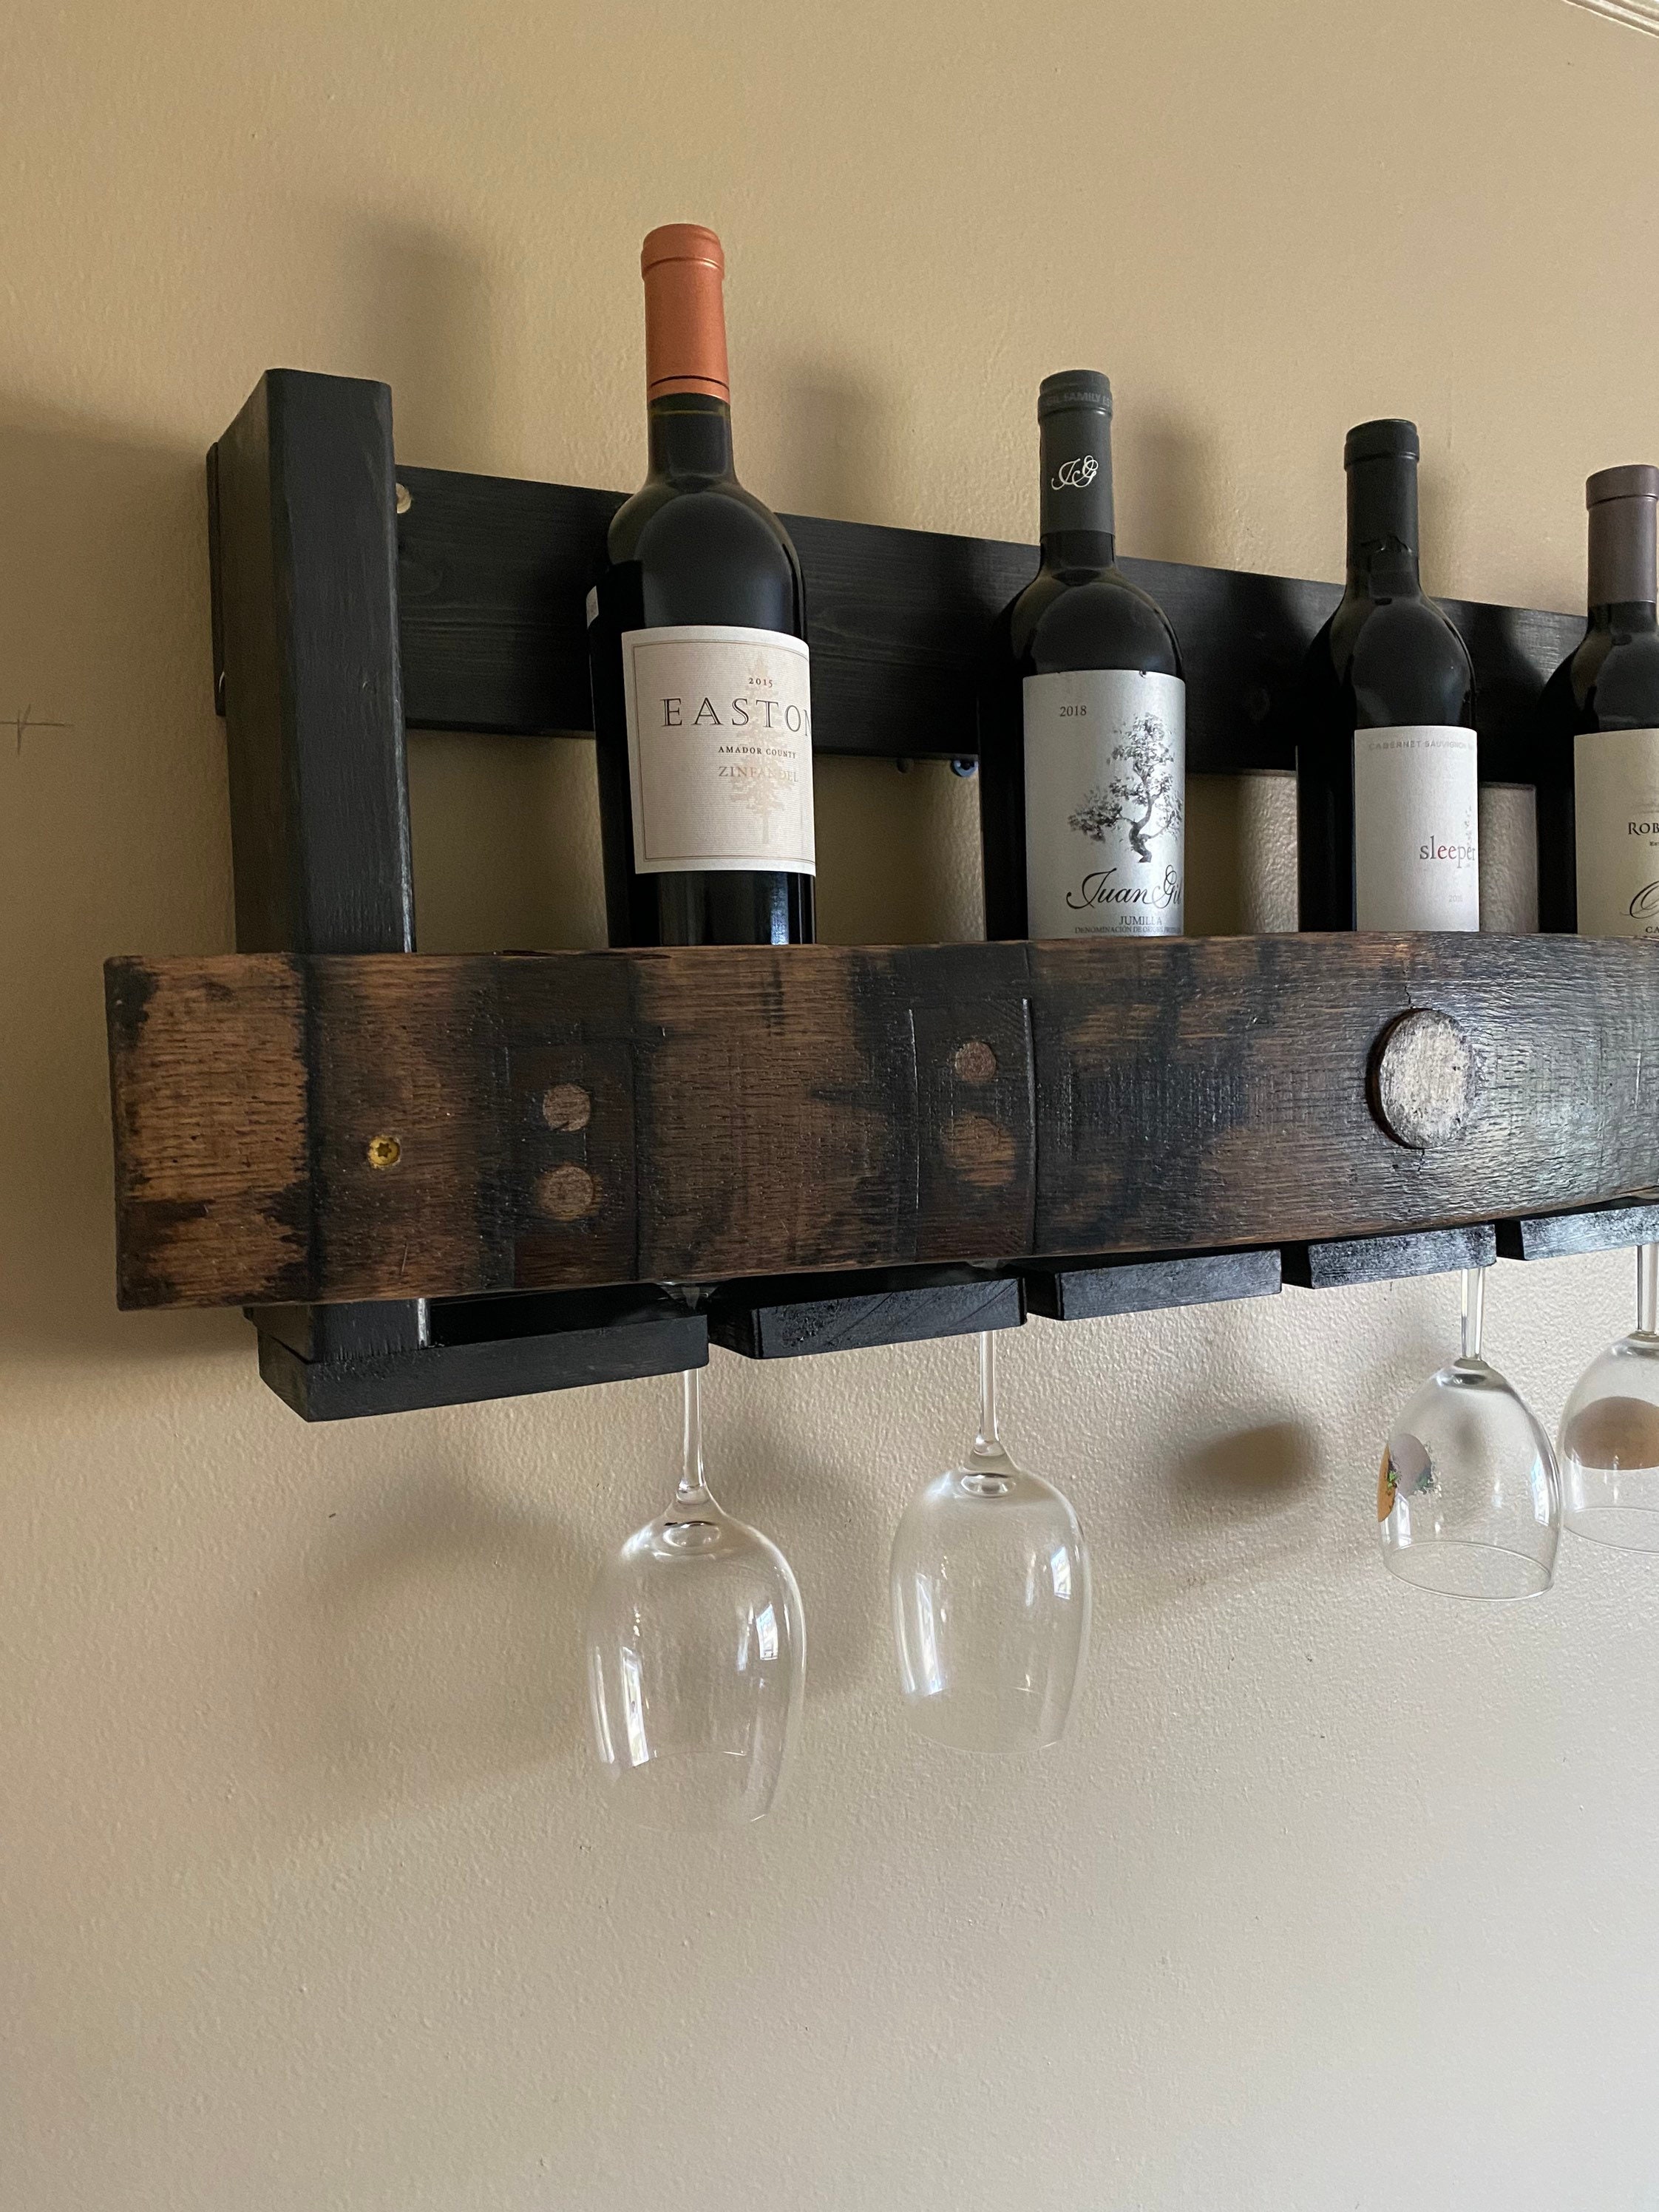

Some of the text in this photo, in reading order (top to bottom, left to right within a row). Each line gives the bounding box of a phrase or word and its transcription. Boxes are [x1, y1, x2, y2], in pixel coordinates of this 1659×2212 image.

[748, 677, 773, 688] 2015
[1059, 705, 1087, 716] 2018
[718, 746, 796, 759] AMADOR COUNTY
[1066, 868, 1152, 909] Juan
[1119, 916, 1162, 926] JUMILLA
